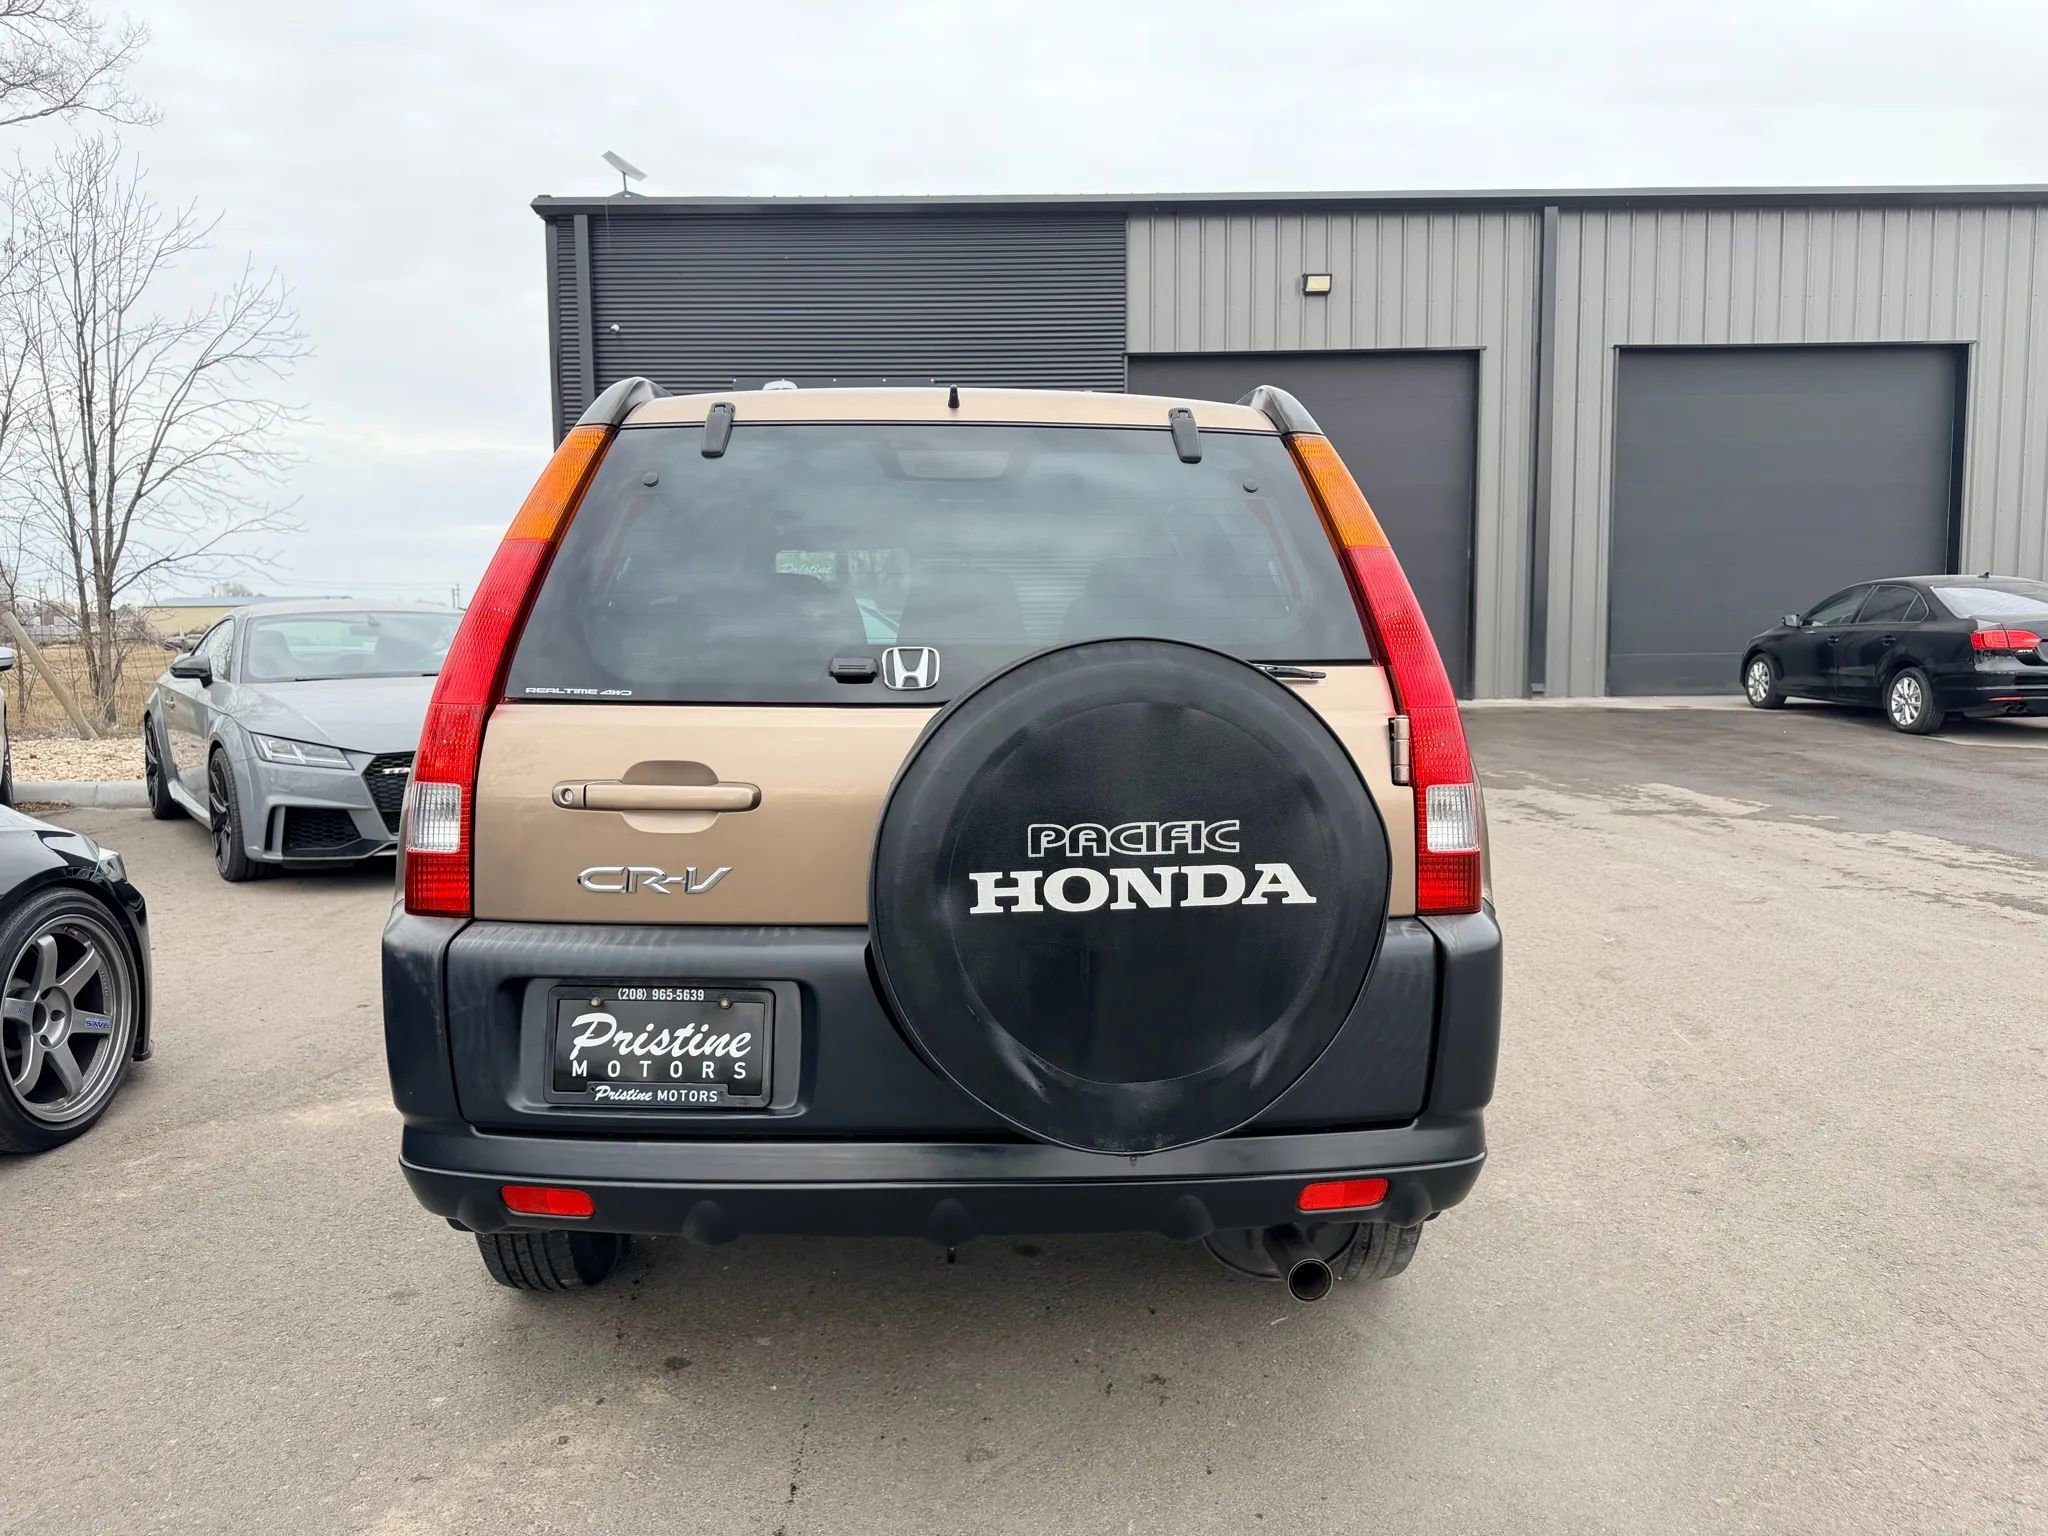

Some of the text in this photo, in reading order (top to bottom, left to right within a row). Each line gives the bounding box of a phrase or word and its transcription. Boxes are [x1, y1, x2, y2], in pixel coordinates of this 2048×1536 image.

[1028, 820, 1239, 857] PACIFIC
[577, 866, 734, 894] CR-V
[969, 863, 1316, 914] HONDA
[617, 988, 705, 1001] (208) 965-5639
[570, 1013, 751, 1061] Pristine
[570, 1060, 747, 1080] MOTORS
[595, 1086, 717, 1102] Pristine MOTORS
